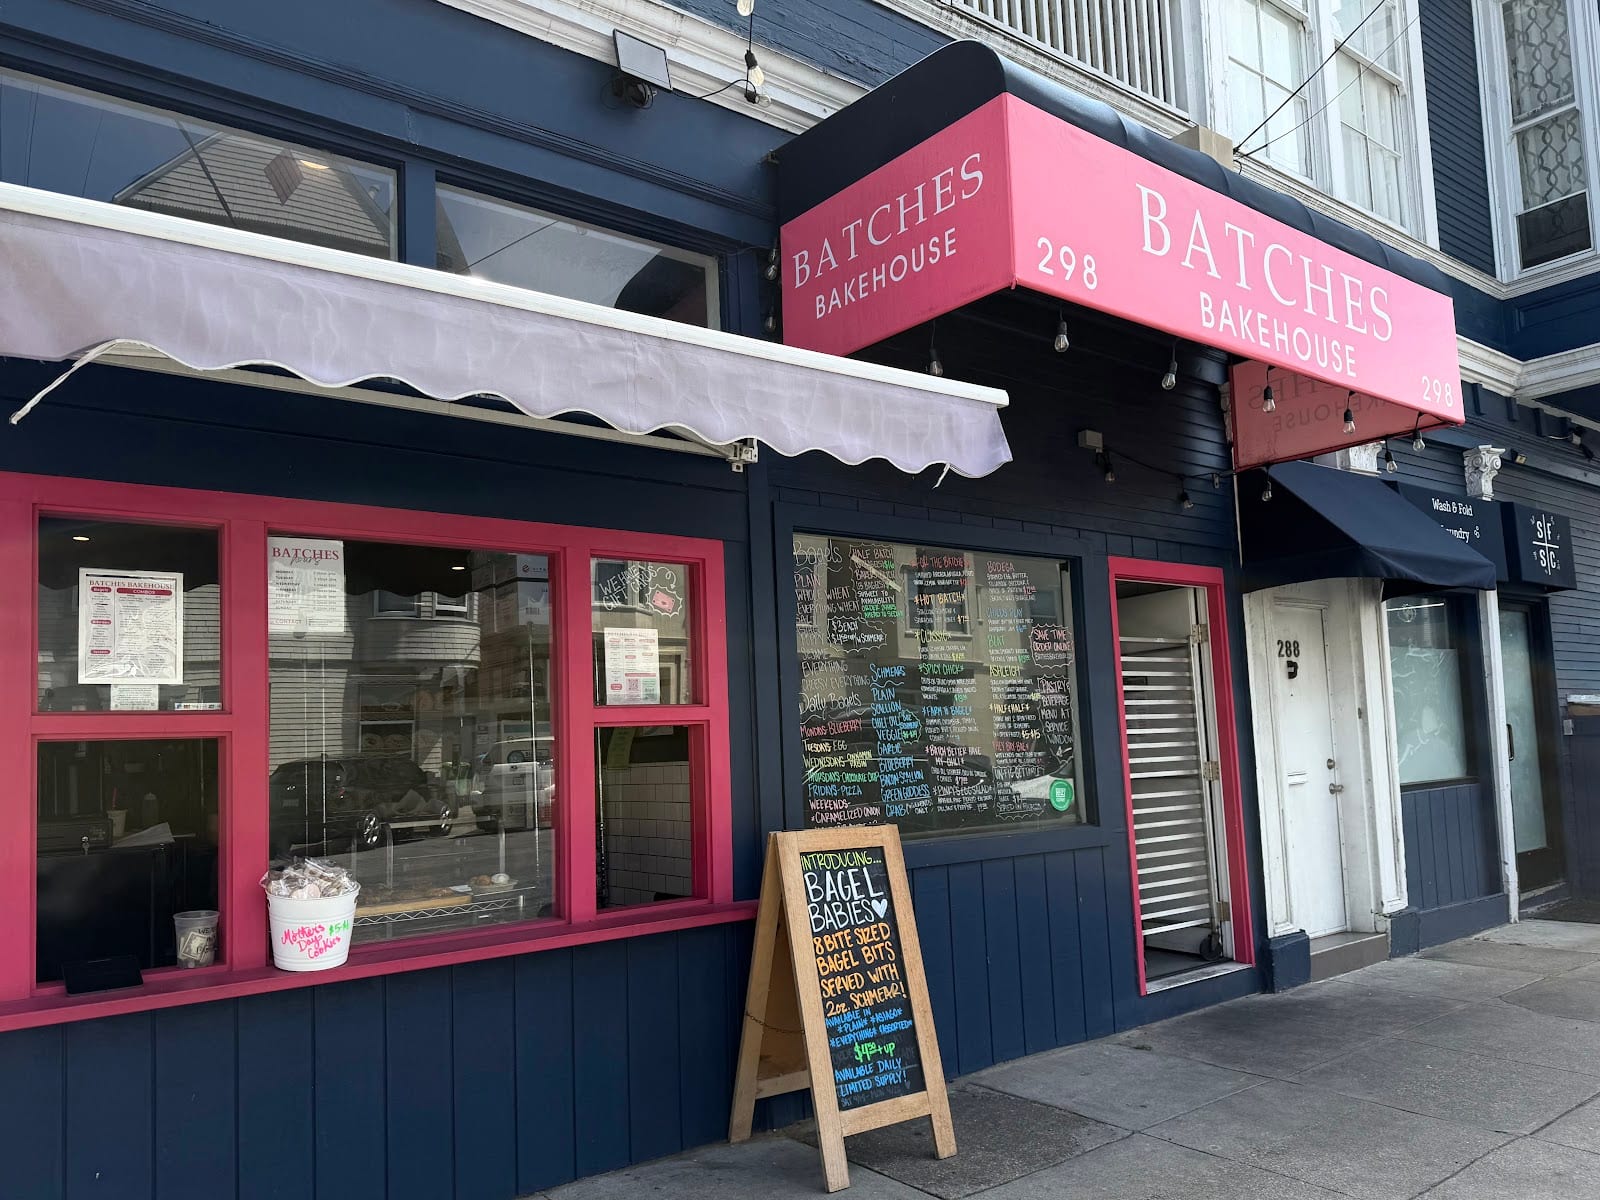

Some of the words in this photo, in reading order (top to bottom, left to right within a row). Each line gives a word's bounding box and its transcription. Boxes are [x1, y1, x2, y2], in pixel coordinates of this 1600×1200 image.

[792, 153, 984, 289] BATCHES
[816, 227, 957, 319] BAKEHOUSE
[1037, 236, 1098, 290] 298
[1135, 182, 1393, 342] BATCHES
[1199, 290, 1358, 378] BAKEHOUSE
[1421, 375, 1454, 408] 298
[1431, 497, 1452, 513] Wash
[1451, 501, 1458, 514] &
[1458, 502, 1474, 517] Fold
[272, 547, 340, 561] BATCHES
[127, 581, 175, 590] BAKEHOUSE
[599, 576, 622, 596] WE
[618, 564, 641, 586] HAVE
[602, 586, 628, 611] GIFT
[631, 564, 658, 593] CARDS
[1277, 639, 1300, 658] 288
[871, 688, 895, 701] PLAIN
[832, 740, 848, 751] EGG
[841, 785, 863, 796] PIZZA
[800, 851, 882, 871] INTRODUCING...
[804, 866, 884, 902] BAGEL
[808, 898, 875, 933] BABIES
[813, 936, 825, 955] 8
[823, 928, 854, 953] BITE
[853, 922, 891, 945] SIZED
[816, 949, 860, 977] BAGEL
[861, 940, 897, 965] BITS
[820, 972, 865, 999] SERVED
[867, 963, 900, 984] WITH
[849, 981, 908, 1010] SCHMEAR!
[825, 1008, 860, 1029] AVAILABLE
[863, 1007, 872, 1017] IN
[834, 1062, 874, 1083] AVAILABLE
[876, 1058, 902, 1073] DAILY
[839, 1079, 872, 1097] LIMITED
[874, 1070, 907, 1087] SUPPLY!
